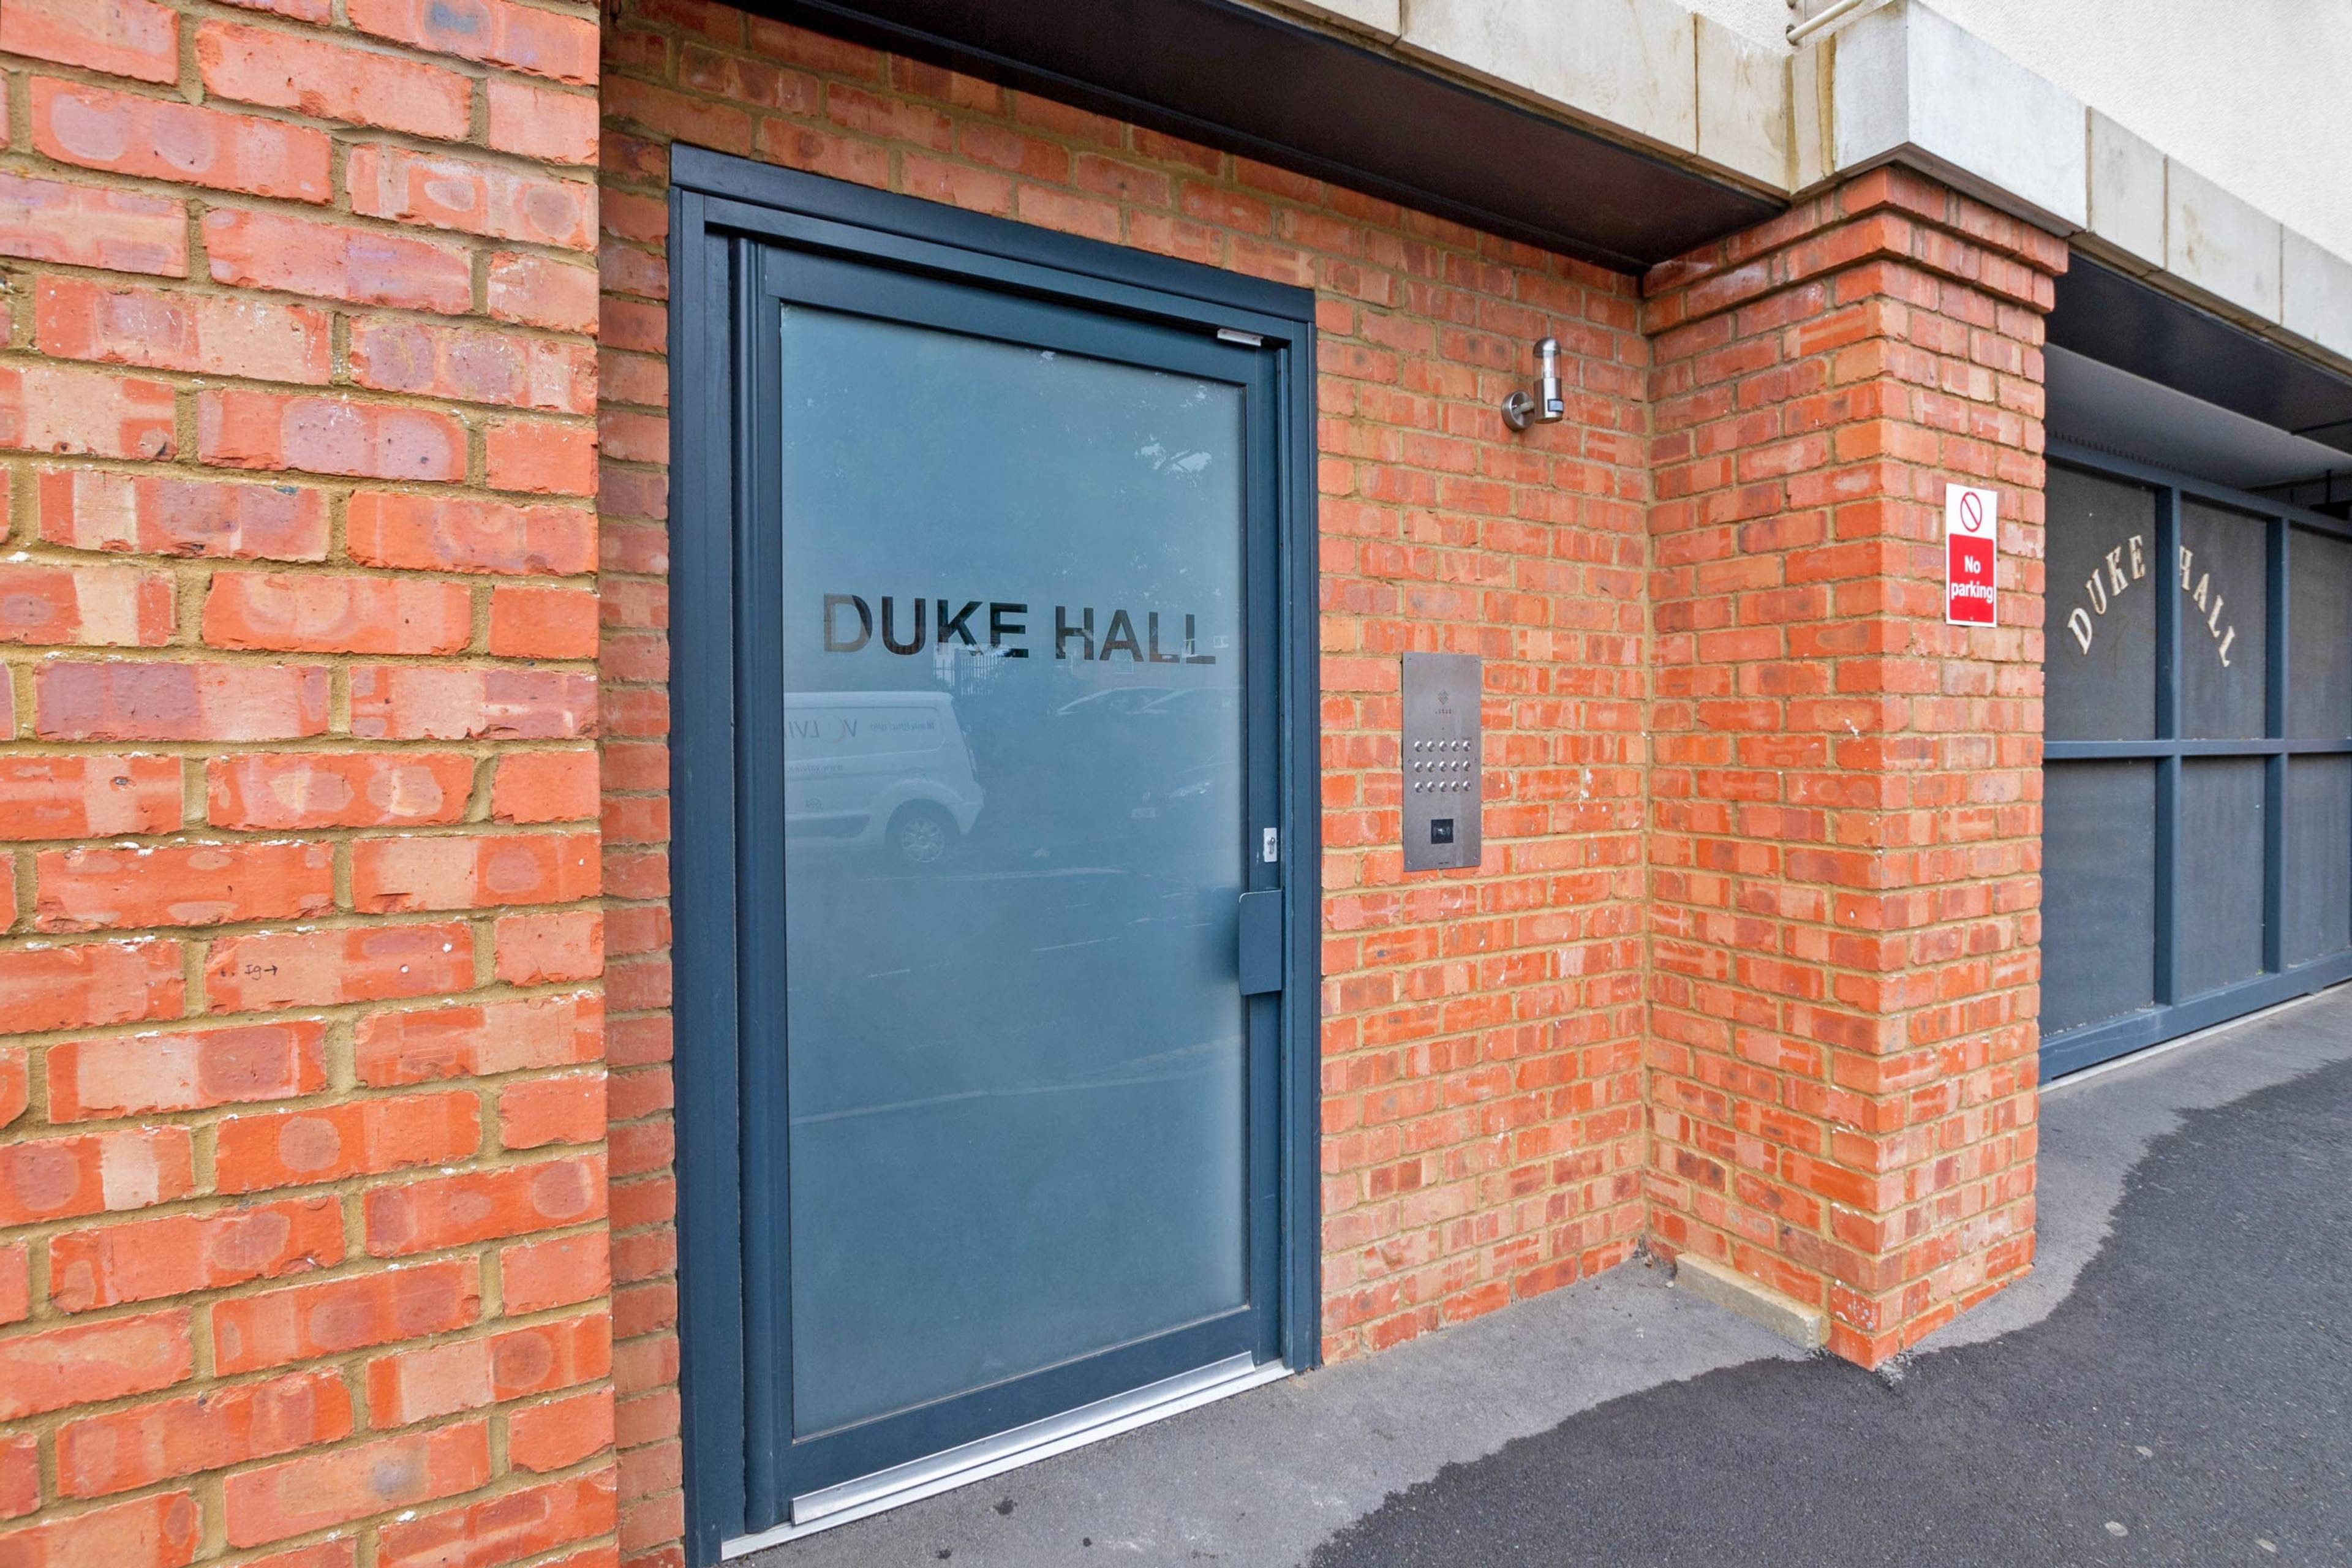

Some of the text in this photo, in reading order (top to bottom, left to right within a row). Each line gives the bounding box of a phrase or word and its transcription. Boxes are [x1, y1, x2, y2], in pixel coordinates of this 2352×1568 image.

[1964, 555, 1981, 573] No
[1951, 580, 1994, 604] parking
[2068, 535, 2235, 666] DUKE HALL
[824, 594, 1216, 664] DUKE HALL
